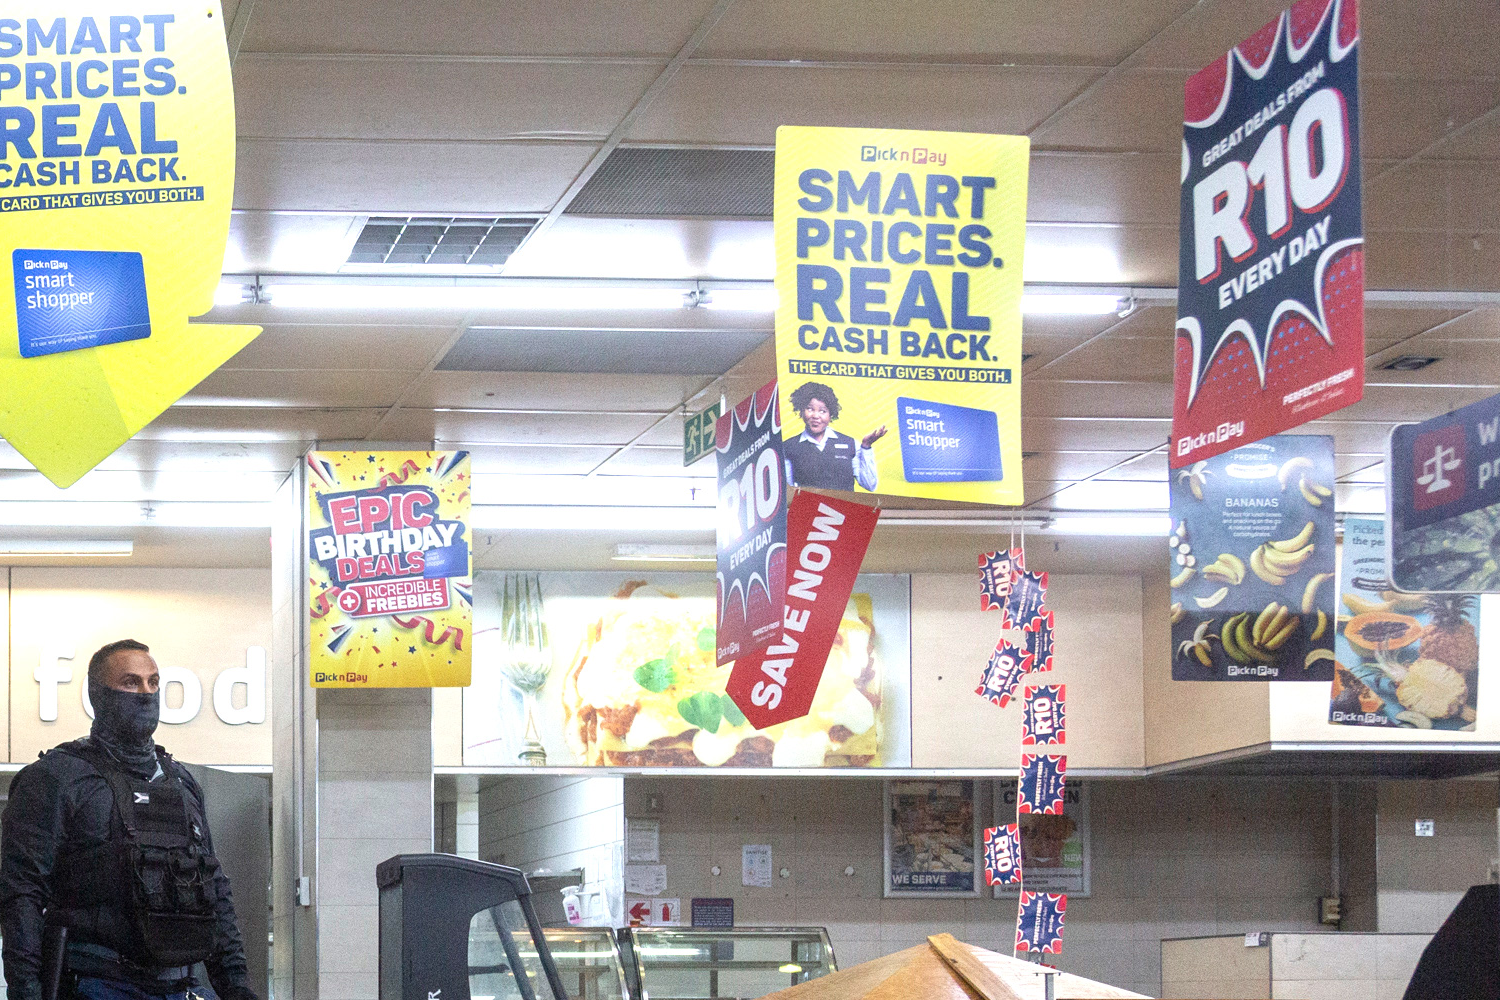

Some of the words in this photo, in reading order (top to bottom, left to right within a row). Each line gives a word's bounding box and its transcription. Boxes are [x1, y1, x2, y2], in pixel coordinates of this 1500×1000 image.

[1203, 124, 1245, 167] GREAT
[1245, 93, 1286, 137] DEALS
[1287, 62, 1325, 106] FROM
[91, 157, 186, 184] BACK.
[861, 146, 898, 163] Pick
[901, 150, 909, 162] n
[912, 147, 947, 166] Pay
[1, 196, 41, 211] CARD
[43, 194, 79, 208] THAT
[81, 192, 123, 206] GIVES
[125, 190, 156, 204] YOU
[159, 188, 201, 202] BOTH.
[797, 168, 996, 219] SMART
[1193, 88, 1348, 283] R10
[796, 217, 1004, 268] PRICES.
[24, 260, 45, 270] Pick
[50, 260, 68, 270] Pay
[1219, 250, 1286, 310] EVERY
[1289, 215, 1331, 266] DAY
[25, 272, 74, 289] smart
[26, 290, 94, 310] shopper
[797, 264, 991, 332] REAL
[797, 325, 888, 355] CASH
[900, 330, 998, 362] BACK.
[791, 361, 817, 374] THE
[820, 363, 857, 376] CARD
[859, 365, 893, 378] THAT
[896, 366, 935, 380] GIVES
[937, 368, 965, 381] YOU
[969, 370, 1009, 383] BOTH.
[906, 419, 945, 432] smart
[908, 431, 960, 450] shopper
[1177, 433, 1209, 456] Pick
[1216, 421, 1245, 443] Pay
[328, 491, 435, 535] EPIC
[719, 448, 781, 549] R10
[1225, 498, 1279, 508] BANANAS
[314, 523, 460, 561] BIRTHDAY
[730, 540, 755, 571] EVERY
[755, 525, 774, 549] DAY
[1353, 537, 1368, 545] the
[336, 551, 426, 582] DEALS
[992, 560, 1012, 597] R10
[365, 580, 441, 598] INCREDIBLE
[366, 592, 444, 613] FREEBIES
[750, 605, 811, 710] SAVE
[787, 502, 846, 602] NOW
[34, 645, 267, 725] fod
[315, 672, 337, 682] Pick
[346, 672, 368, 683] Pay
[987, 655, 1016, 693] R10
[1228, 665, 1249, 676] Pick
[1257, 665, 1278, 677] Pay
[1033, 697, 1053, 735] R10
[1333, 711, 1356, 723] Pick
[1357, 714, 1364, 722] n
[1364, 712, 1388, 725] Pay
[994, 835, 1013, 873] R10
[892, 875, 909, 884] WE
[912, 874, 947, 884] SERVE
[1033, 917, 1041, 944] PERFECTLY
